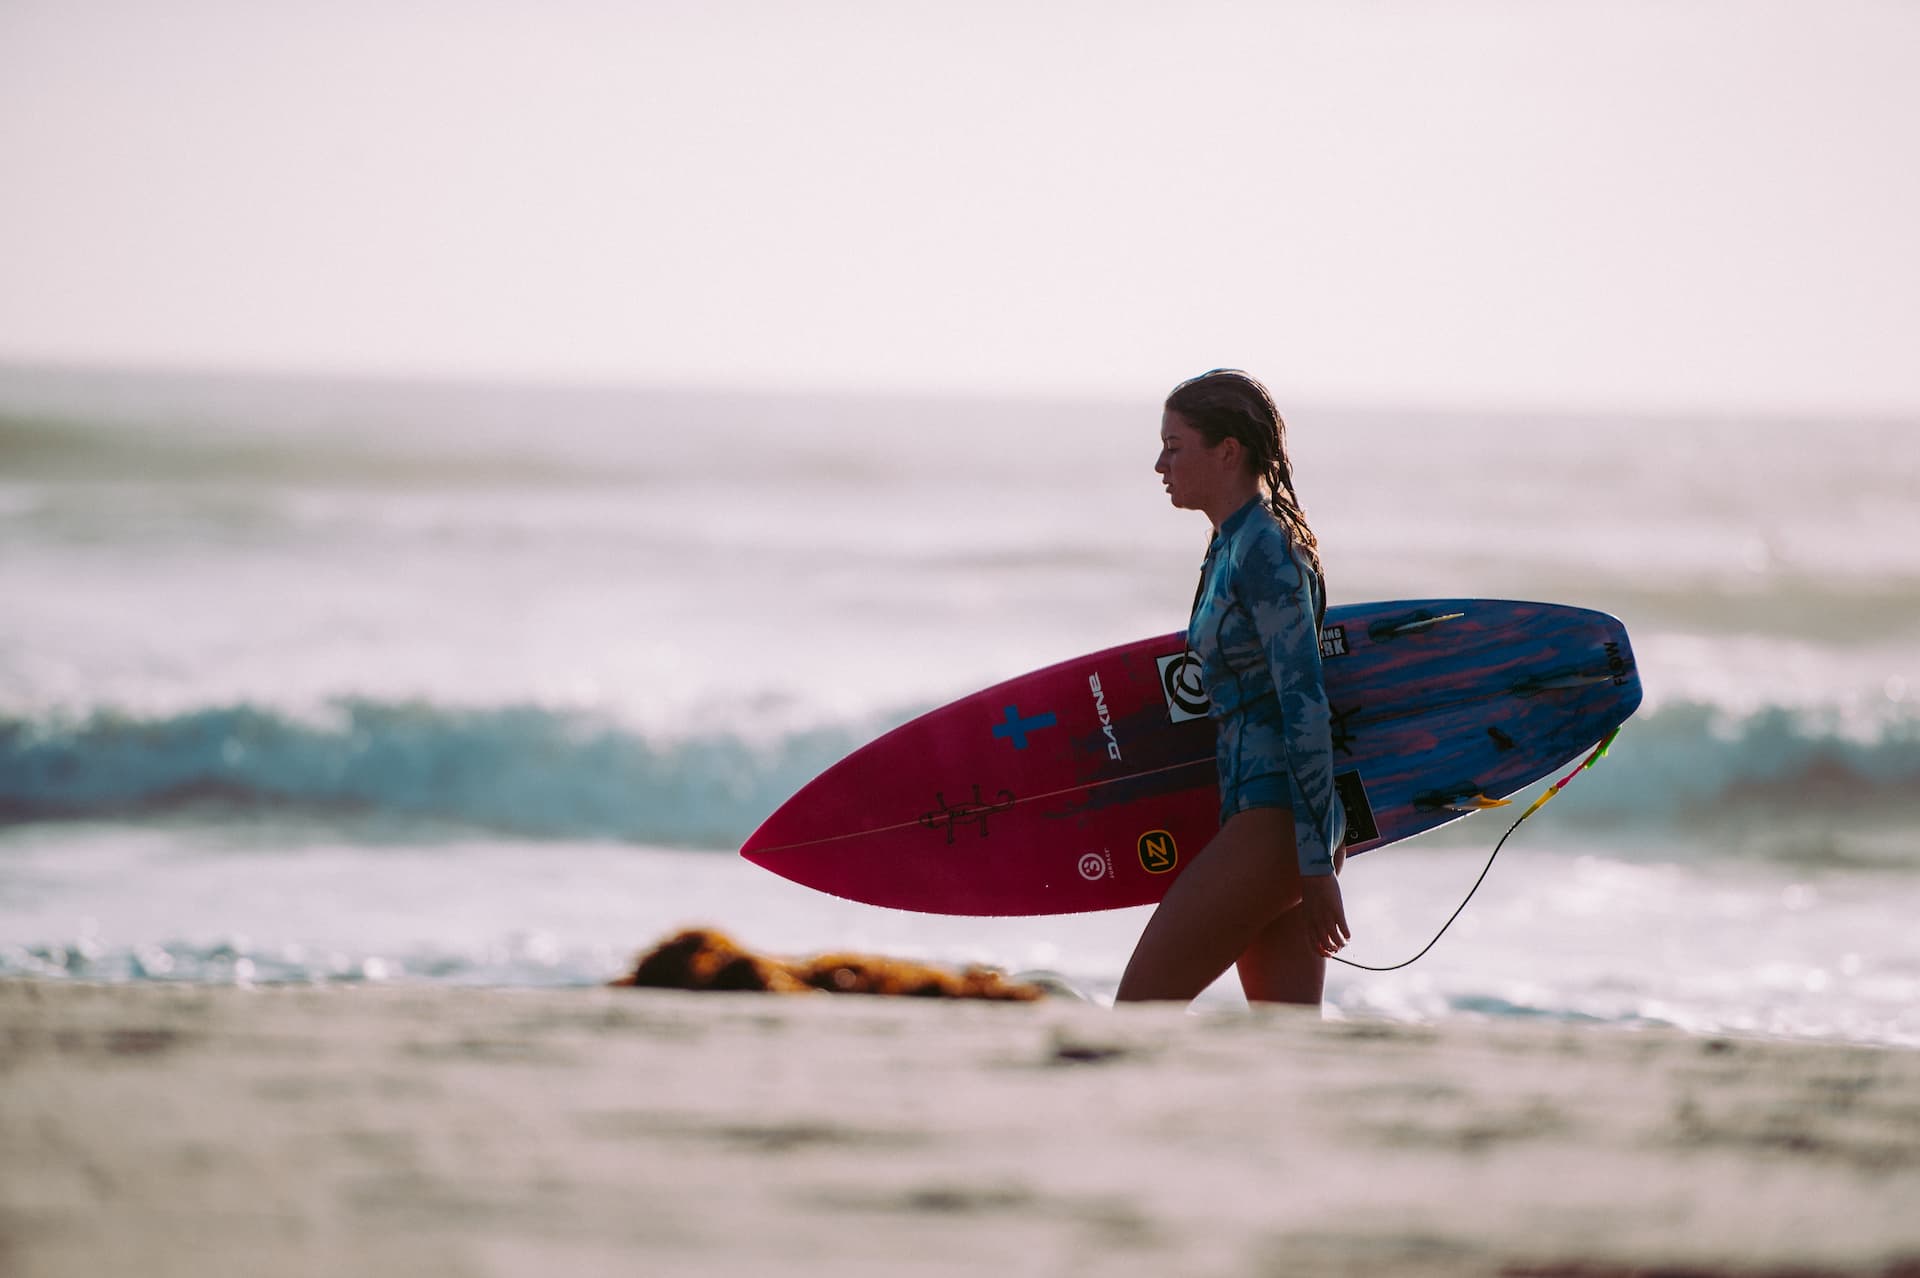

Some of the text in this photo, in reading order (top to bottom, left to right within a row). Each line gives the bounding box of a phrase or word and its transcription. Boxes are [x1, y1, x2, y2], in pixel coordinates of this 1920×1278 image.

[1321, 628, 1341, 641] ING
[1321, 639, 1345, 657] RK
[1604, 642, 1629, 686] FLOW
[1088, 671, 1121, 761] DAKINE
